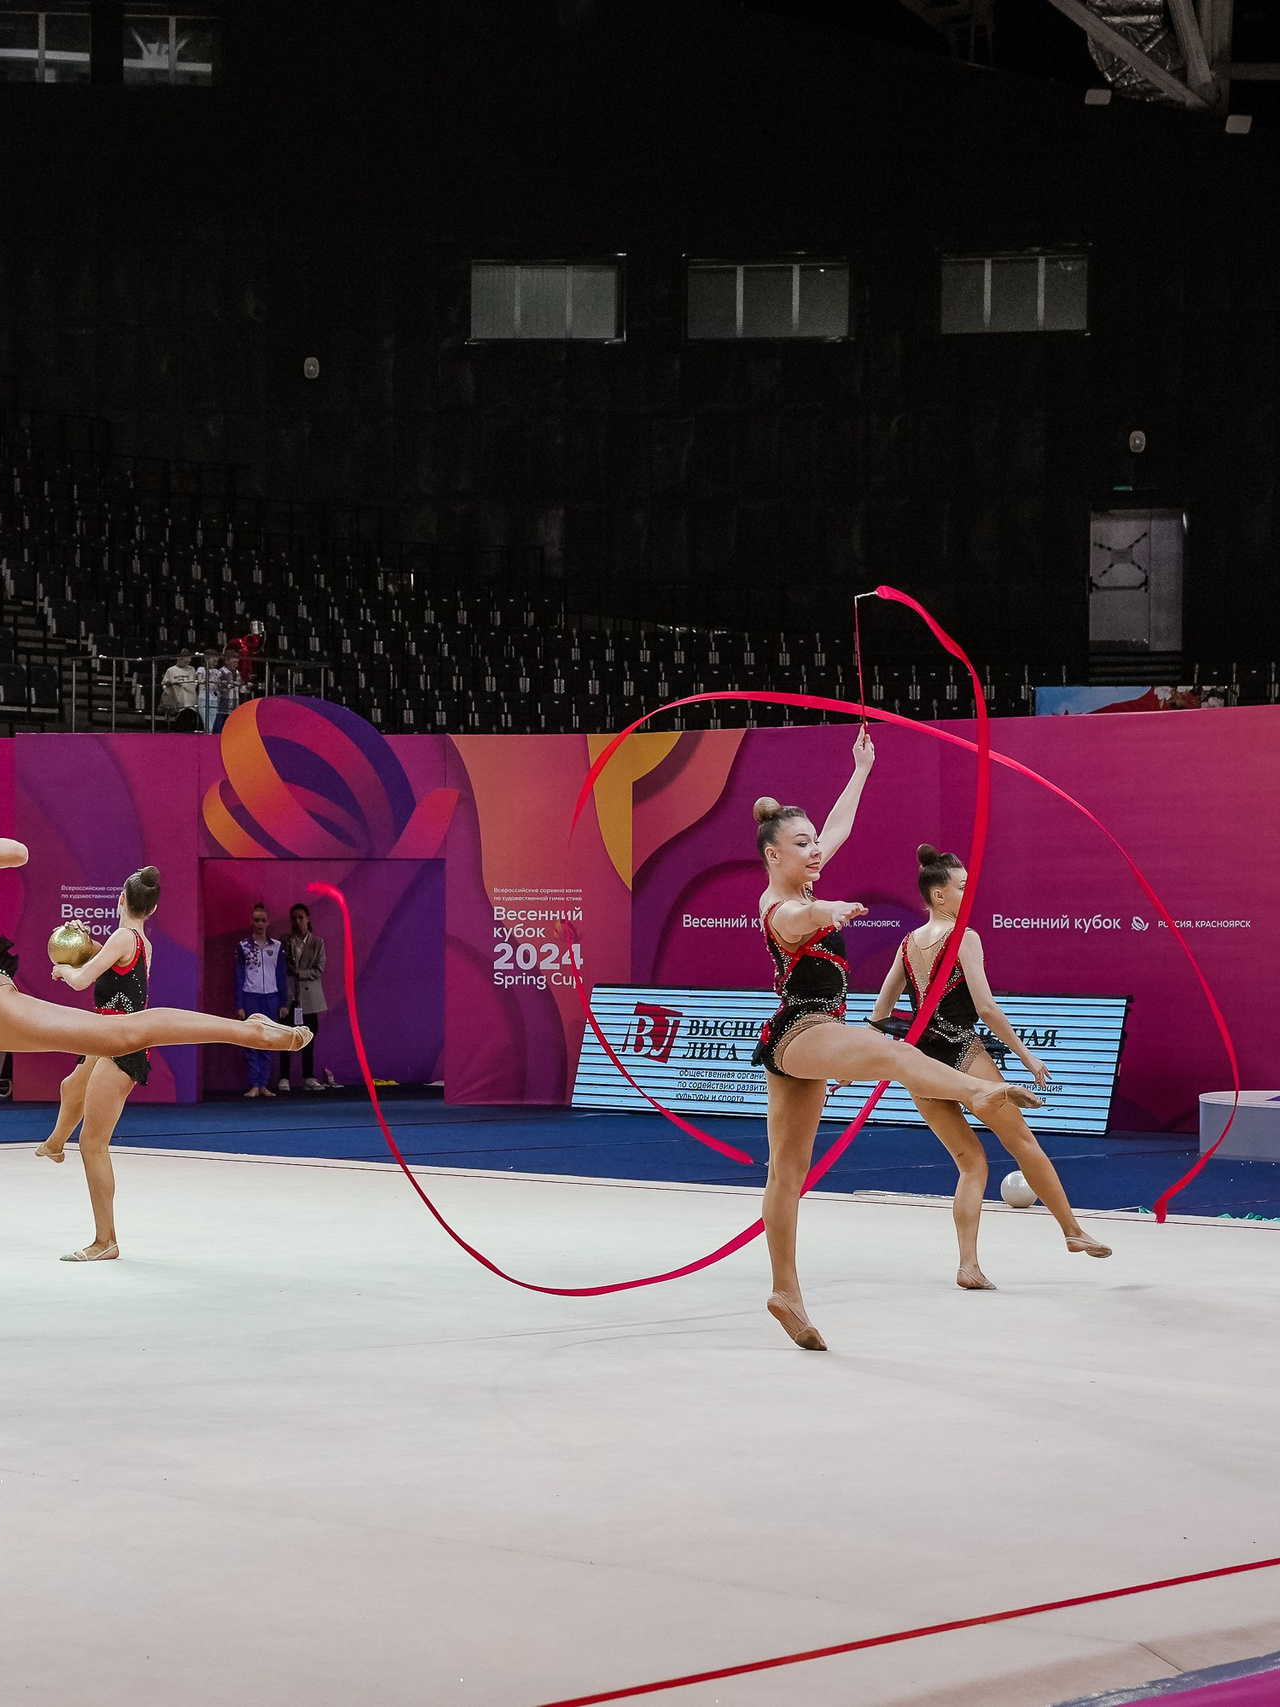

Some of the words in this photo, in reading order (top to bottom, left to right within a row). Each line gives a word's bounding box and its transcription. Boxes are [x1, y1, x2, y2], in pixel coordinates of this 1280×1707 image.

[61, 904, 121, 918] Весен
[493, 906, 583, 921] Весенний
[682, 914, 748, 928] Весенний
[853, 920, 901, 928] КРАСНОЯРСК
[992, 914, 1070, 929] Весенний
[1074, 915, 1122, 933] кубок
[1195, 920, 1251, 928] КРАСНОЯРСК
[493, 923, 546, 942] кубок
[493, 942, 584, 970] 2024
[493, 972, 547, 990] Spring
[682, 1042, 739, 1061] ЛИГА
[679, 1069, 735, 1079] общественная
[688, 1081, 735, 1091] содействию
[736, 1083, 767, 1092] развити
